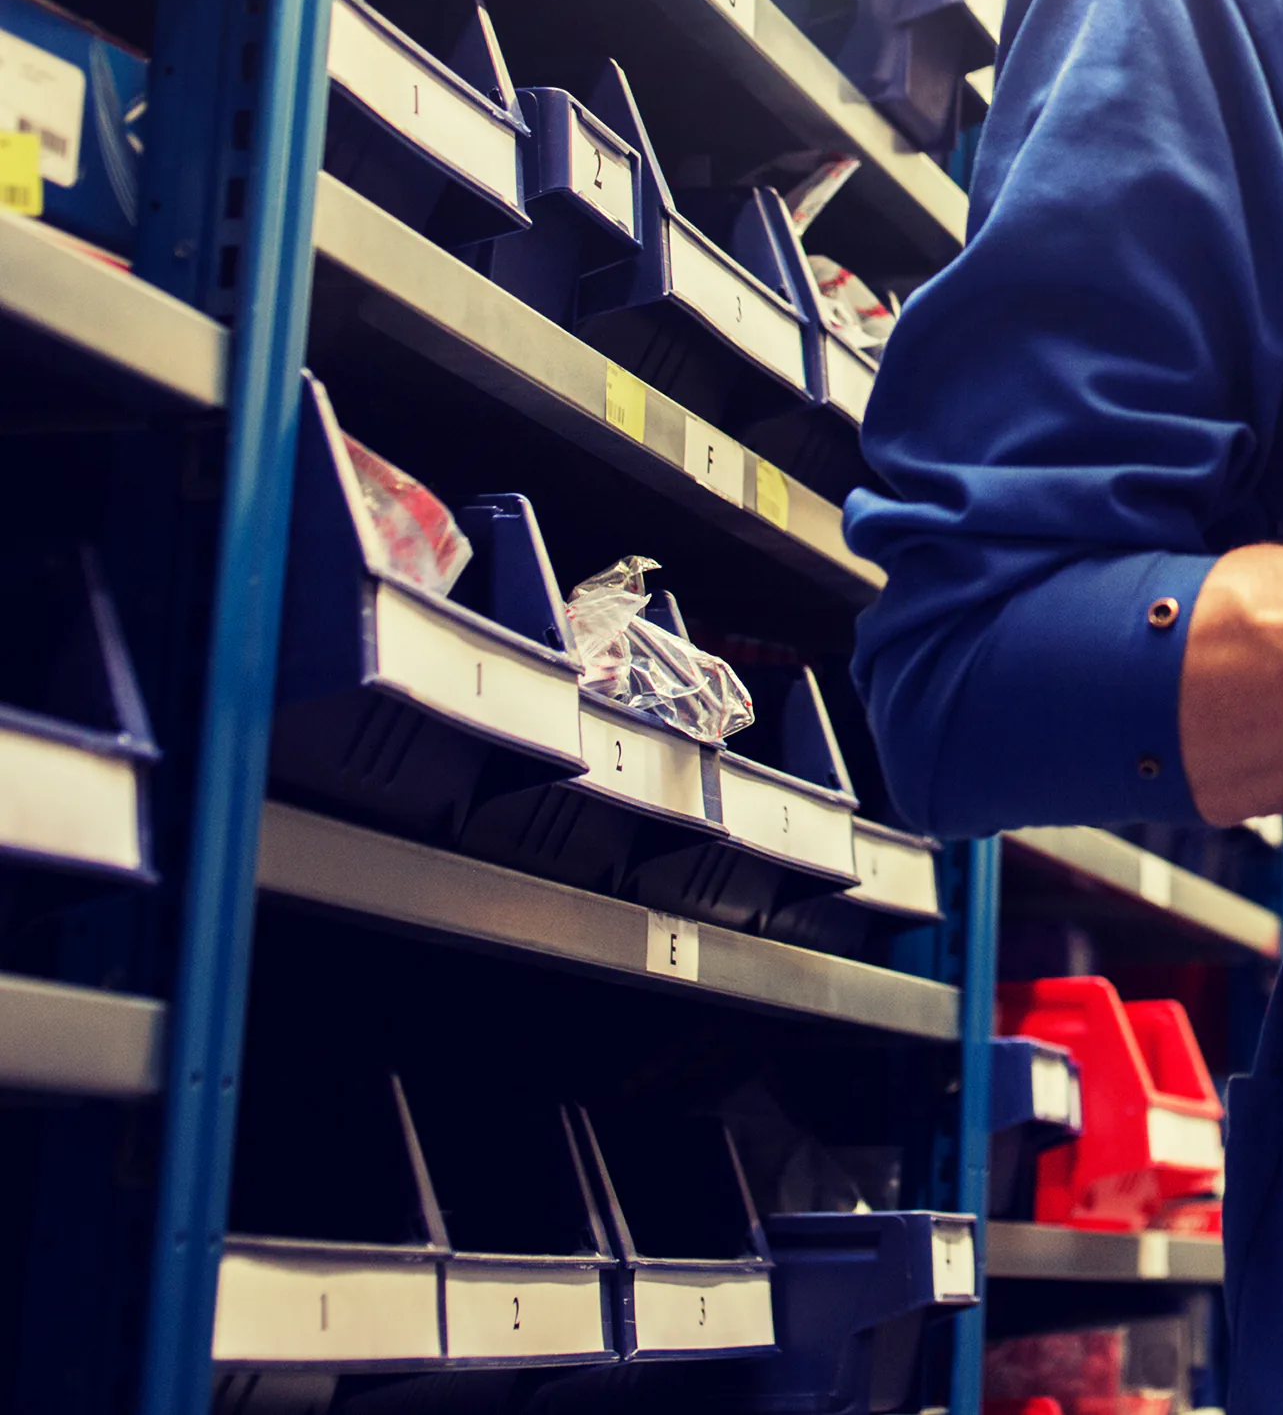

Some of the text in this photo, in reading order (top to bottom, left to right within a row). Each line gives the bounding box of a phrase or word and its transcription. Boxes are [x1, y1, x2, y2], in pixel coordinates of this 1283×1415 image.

[413, 84, 419, 116] 1
[593, 147, 602, 191] 2
[735, 295, 742, 323] 3
[707, 445, 714, 474] F
[476, 661, 482, 697] 1
[615, 739, 623, 772] 2
[782, 805, 789, 833] 3
[670, 933, 677, 966] E
[319, 1292, 328, 1332] 1
[512, 1296, 520, 1331] 2
[698, 1295, 706, 1326] 3
